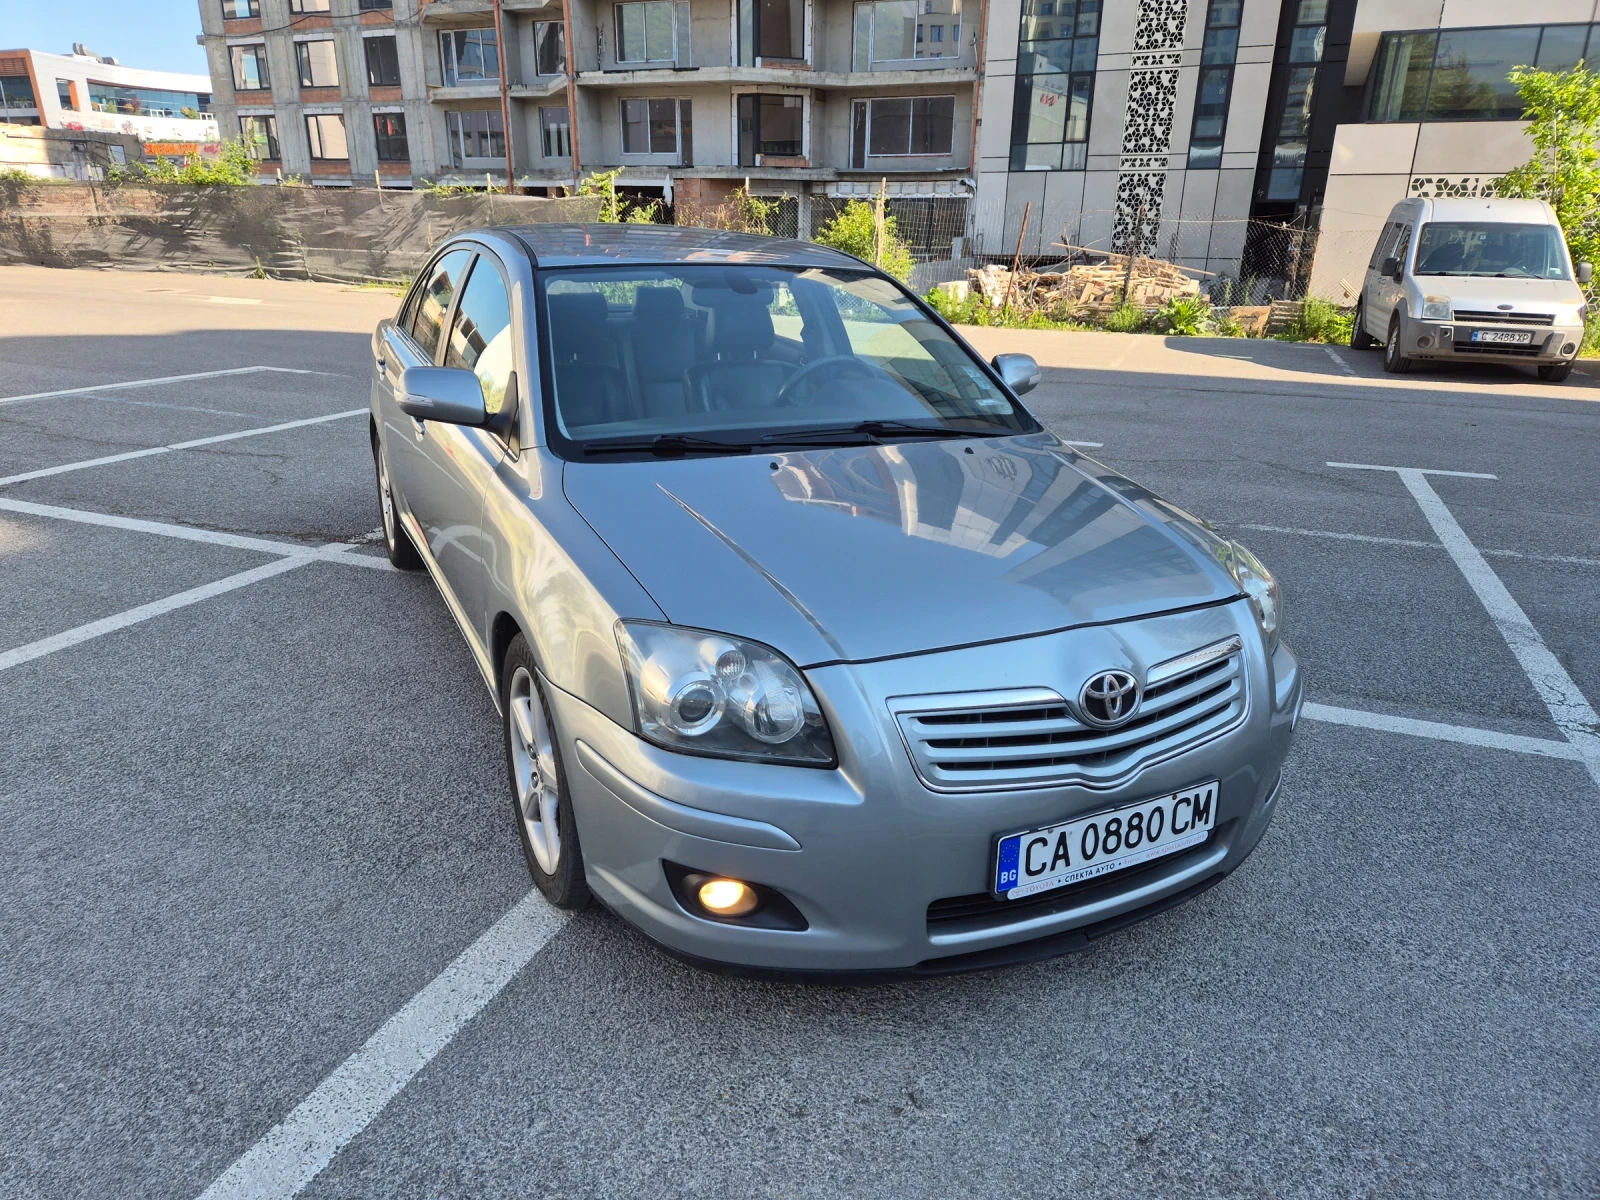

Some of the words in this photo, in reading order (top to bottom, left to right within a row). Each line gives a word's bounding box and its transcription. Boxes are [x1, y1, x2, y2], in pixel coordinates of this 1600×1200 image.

[1481, 332, 1489, 341] C
[1025, 831, 1071, 877] CA
[1081, 806, 1165, 861] 0880
[1171, 789, 1213, 835] CM
[1000, 868, 1017, 885] BG
[1025, 880, 1055, 893] TOYOTA
[1064, 869, 1094, 883] СПЕКТА
[1095, 862, 1116, 875] АУТО
